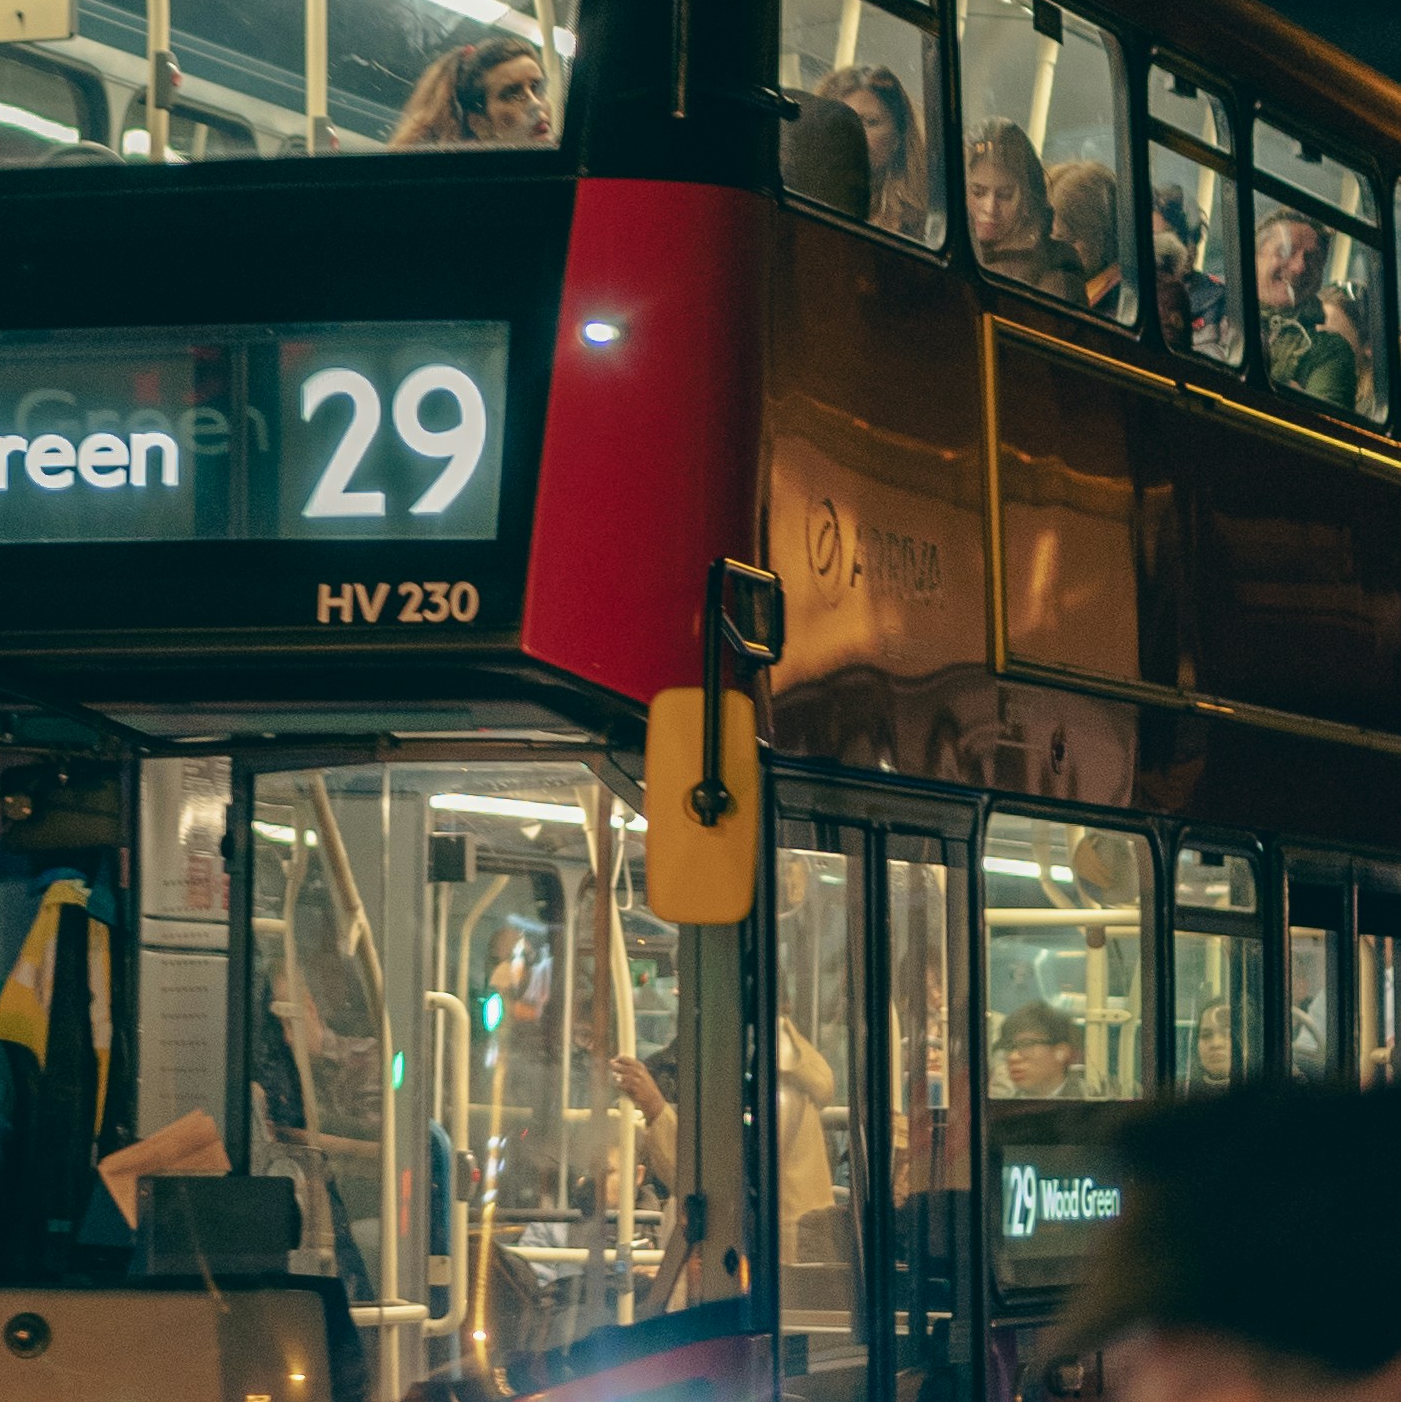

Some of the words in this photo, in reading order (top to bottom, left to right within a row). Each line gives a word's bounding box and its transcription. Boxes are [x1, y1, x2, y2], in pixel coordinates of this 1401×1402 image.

[302, 363, 488, 518] 29
[316, 582, 391, 624] HV
[397, 581, 480, 623] 230
[1008, 1165, 1037, 1237] 29
[1039, 1178, 1080, 1221] Wood
[1082, 1177, 1121, 1218] Green
